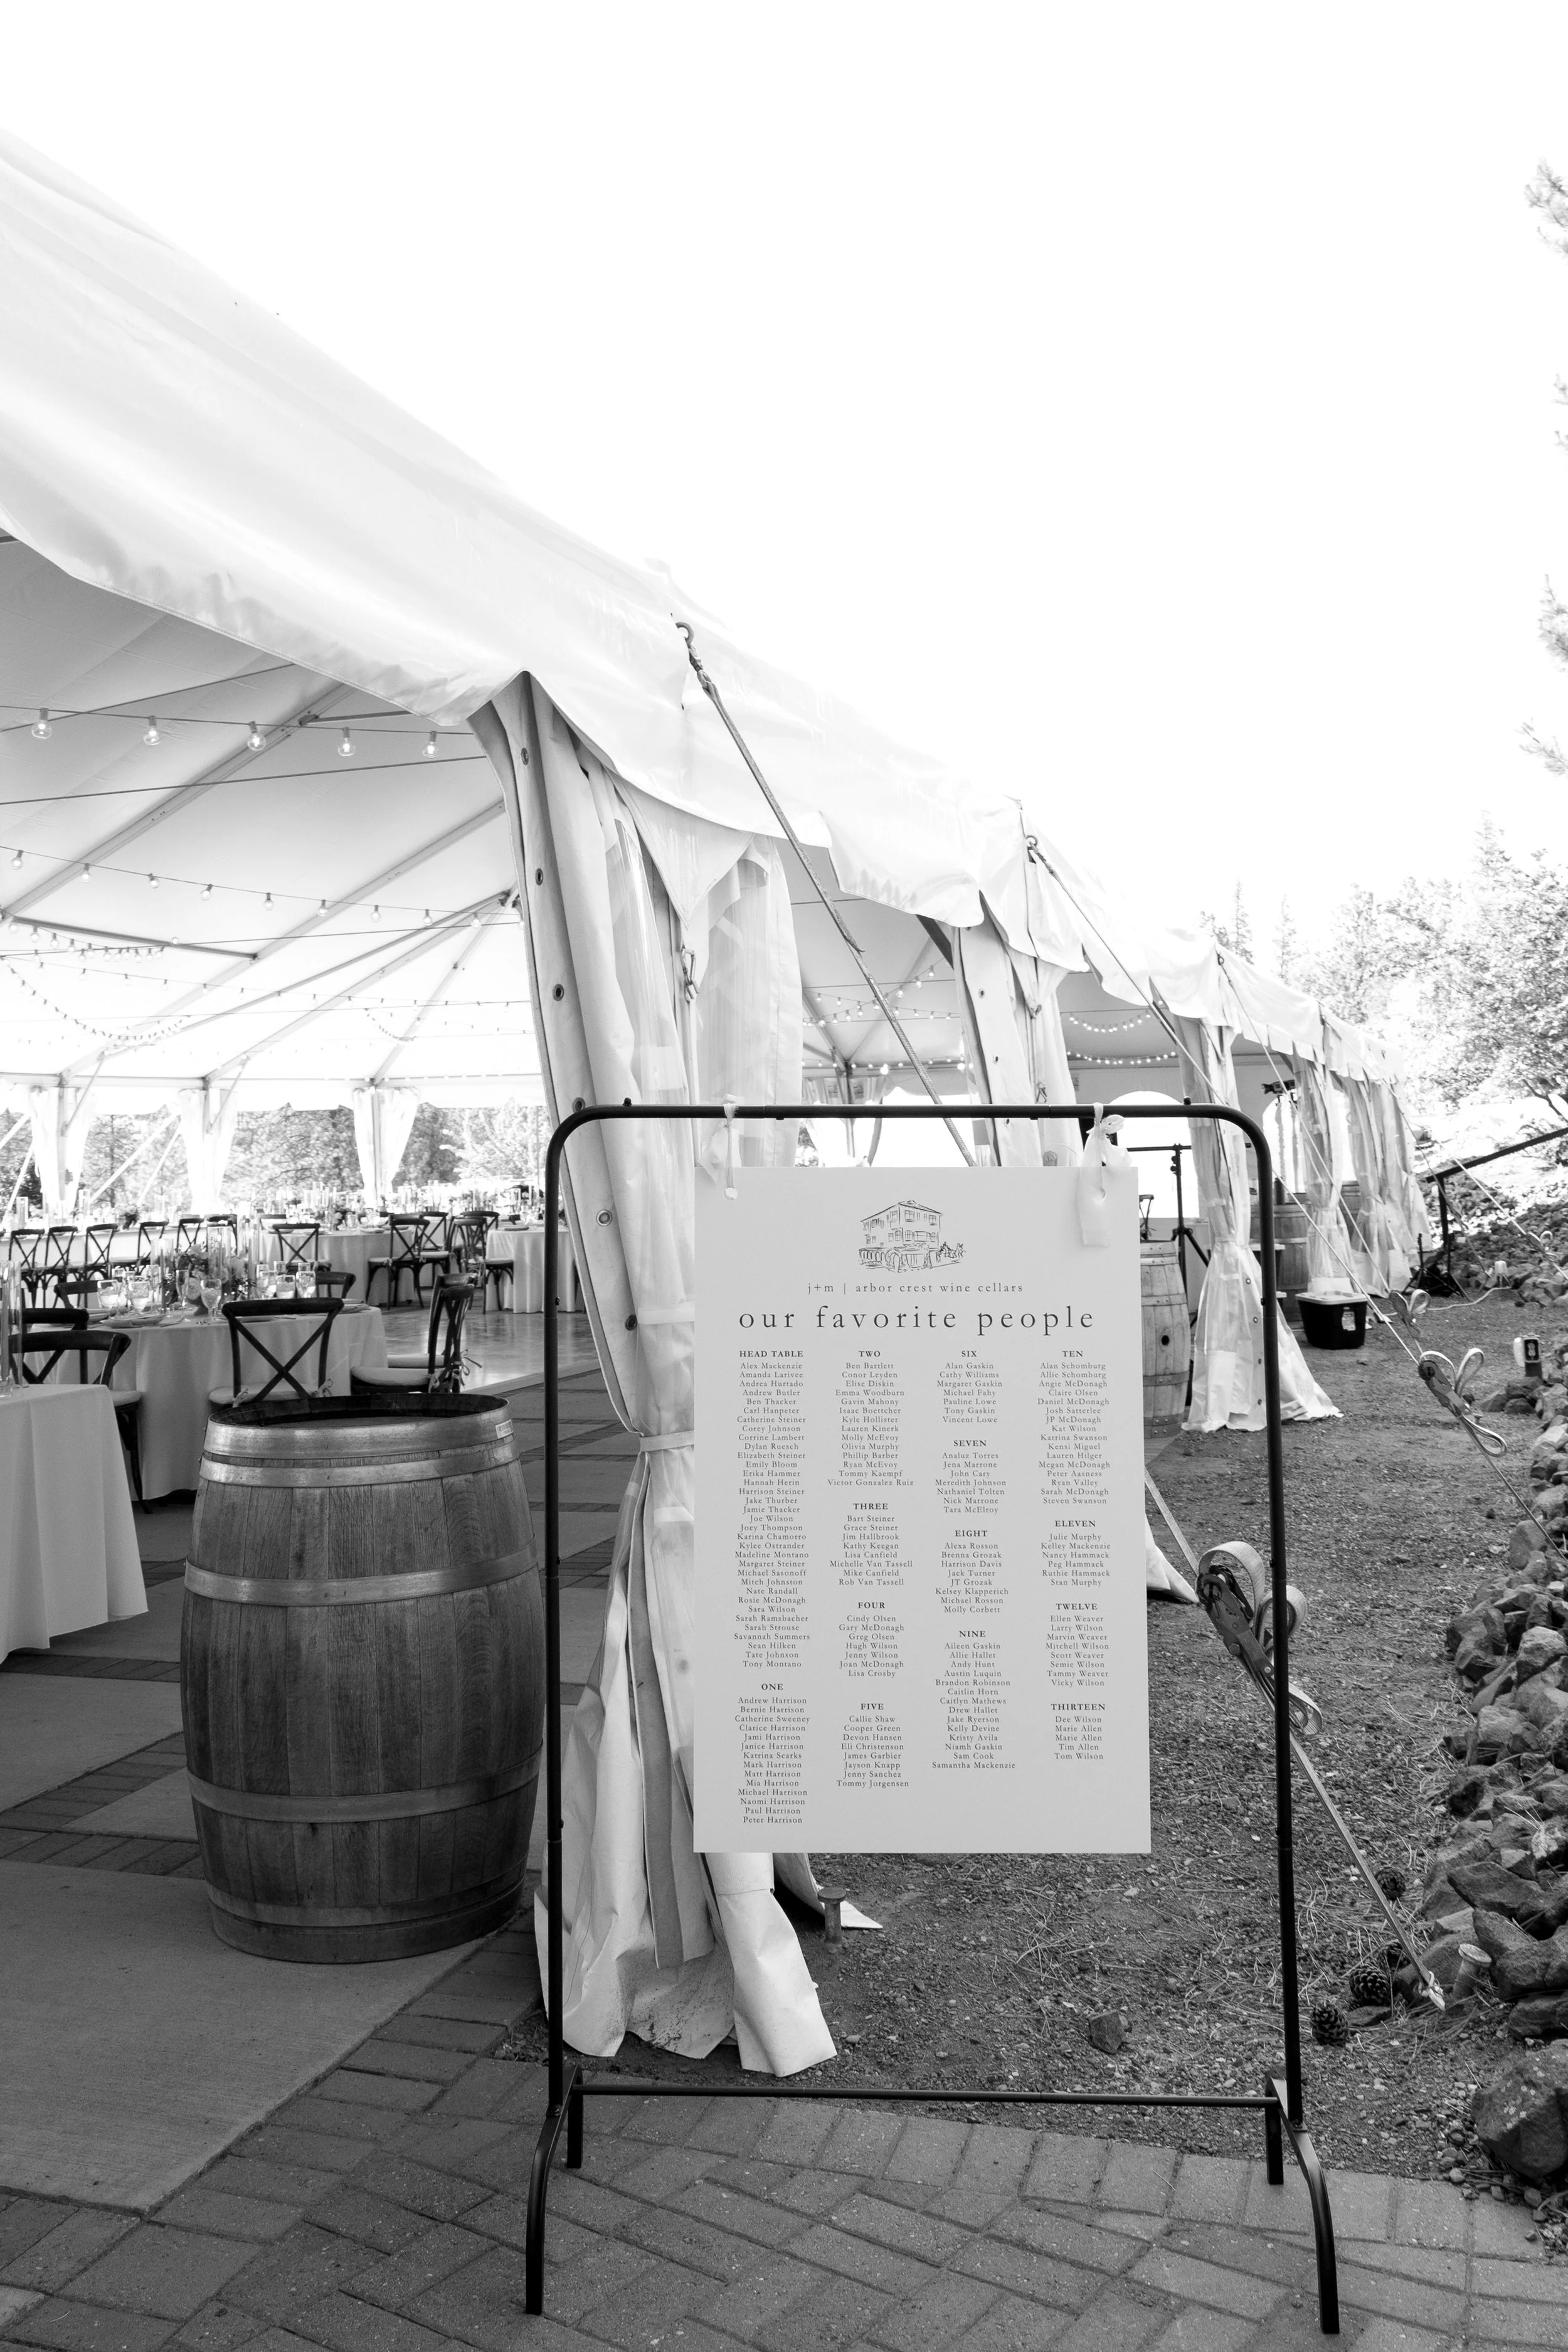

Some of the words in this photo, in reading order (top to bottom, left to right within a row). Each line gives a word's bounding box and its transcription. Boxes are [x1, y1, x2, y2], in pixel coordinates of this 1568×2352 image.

[808, 1283, 834, 1295] j+m
[856, 1283, 893, 1293] arbor
[899, 1284, 933, 1293] crest
[940, 1283, 970, 1293] wine
[978, 1283, 1023, 1293] cellars
[739, 1313, 795, 1328] our
[816, 1305, 956, 1328] favorite
[977, 1305, 1093, 1337] people
[1061, 1362, 1105, 1371] Schomburg
[940, 1371, 962, 1380] Cathy
[868, 1398, 898, 1407] Mahony
[944, 1407, 965, 1416] Tony
[1046, 1416, 1055, 1424] JP
[1059, 1416, 1101, 1424] McDonagh
[742, 1425, 765, 1434] Corey
[768, 1425, 800, 1434] Johnson
[842, 1434, 864, 1443] Molly
[867, 1434, 899, 1443] McEvoy
[869, 1443, 899, 1451] Murphy
[843, 1452, 869, 1461] Phillip
[746, 1461, 768, 1470] Emily
[950, 1470, 969, 1478] John
[972, 1470, 990, 1478] Cary
[1051, 1479, 1070, 1488] Ryan
[1074, 1479, 1098, 1488] Valley
[1066, 1488, 1108, 1496] McDonagh
[965, 1507, 999, 1515] McElroy
[750, 1515, 763, 1523] Joe
[740, 1524, 758, 1533] Joey
[760, 1524, 803, 1533] Thompson
[842, 1533, 856, 1542] Jim
[1049, 1534, 1067, 1542] Julie
[1071, 1534, 1101, 1542] Murphy
[766, 1579, 803, 1587] Johnston
[1071, 1579, 1101, 1587] Murphy
[944, 1606, 966, 1614] Molly
[847, 1615, 869, 1624] Cindy
[1051, 1624, 1072, 1633] Larry
[846, 1642, 867, 1651] Hugh
[743, 1660, 763, 1669] Tony
[951, 1661, 971, 1670] Andy
[867, 1670, 896, 1678] Crosby
[974, 1670, 1001, 1678] Luquin
[1051, 1679, 1073, 1688] Vicky
[744, 1734, 761, 1742] Jami
[950, 1734, 973, 1743] Kristy
[844, 1761, 871, 1770] Jayson
[874, 1761, 901, 1770] Knapp
